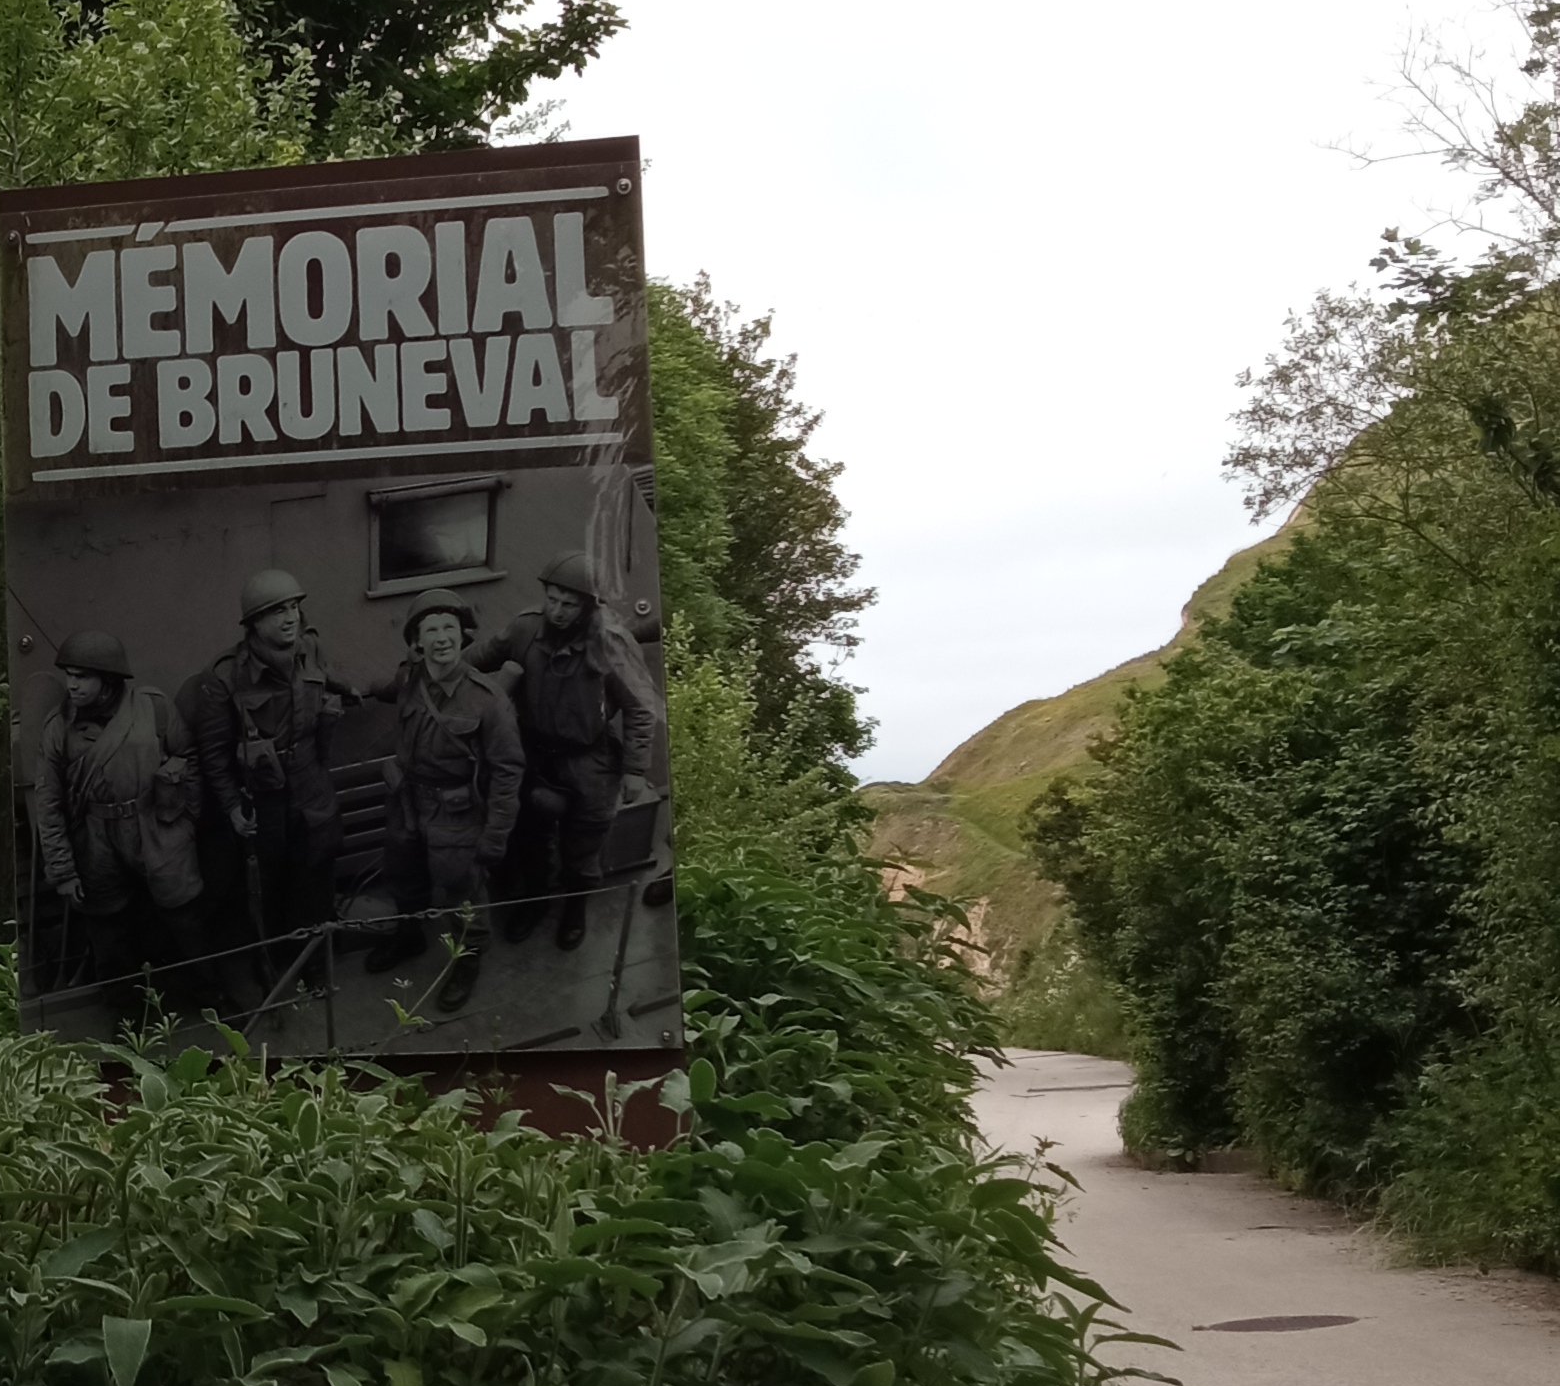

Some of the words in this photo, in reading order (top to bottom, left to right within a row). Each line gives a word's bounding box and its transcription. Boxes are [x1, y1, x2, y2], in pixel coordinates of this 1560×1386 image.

[27, 212, 615, 367] MÉMORIAL
[27, 363, 135, 458] DE
[156, 329, 620, 449] BRUNEVAL
